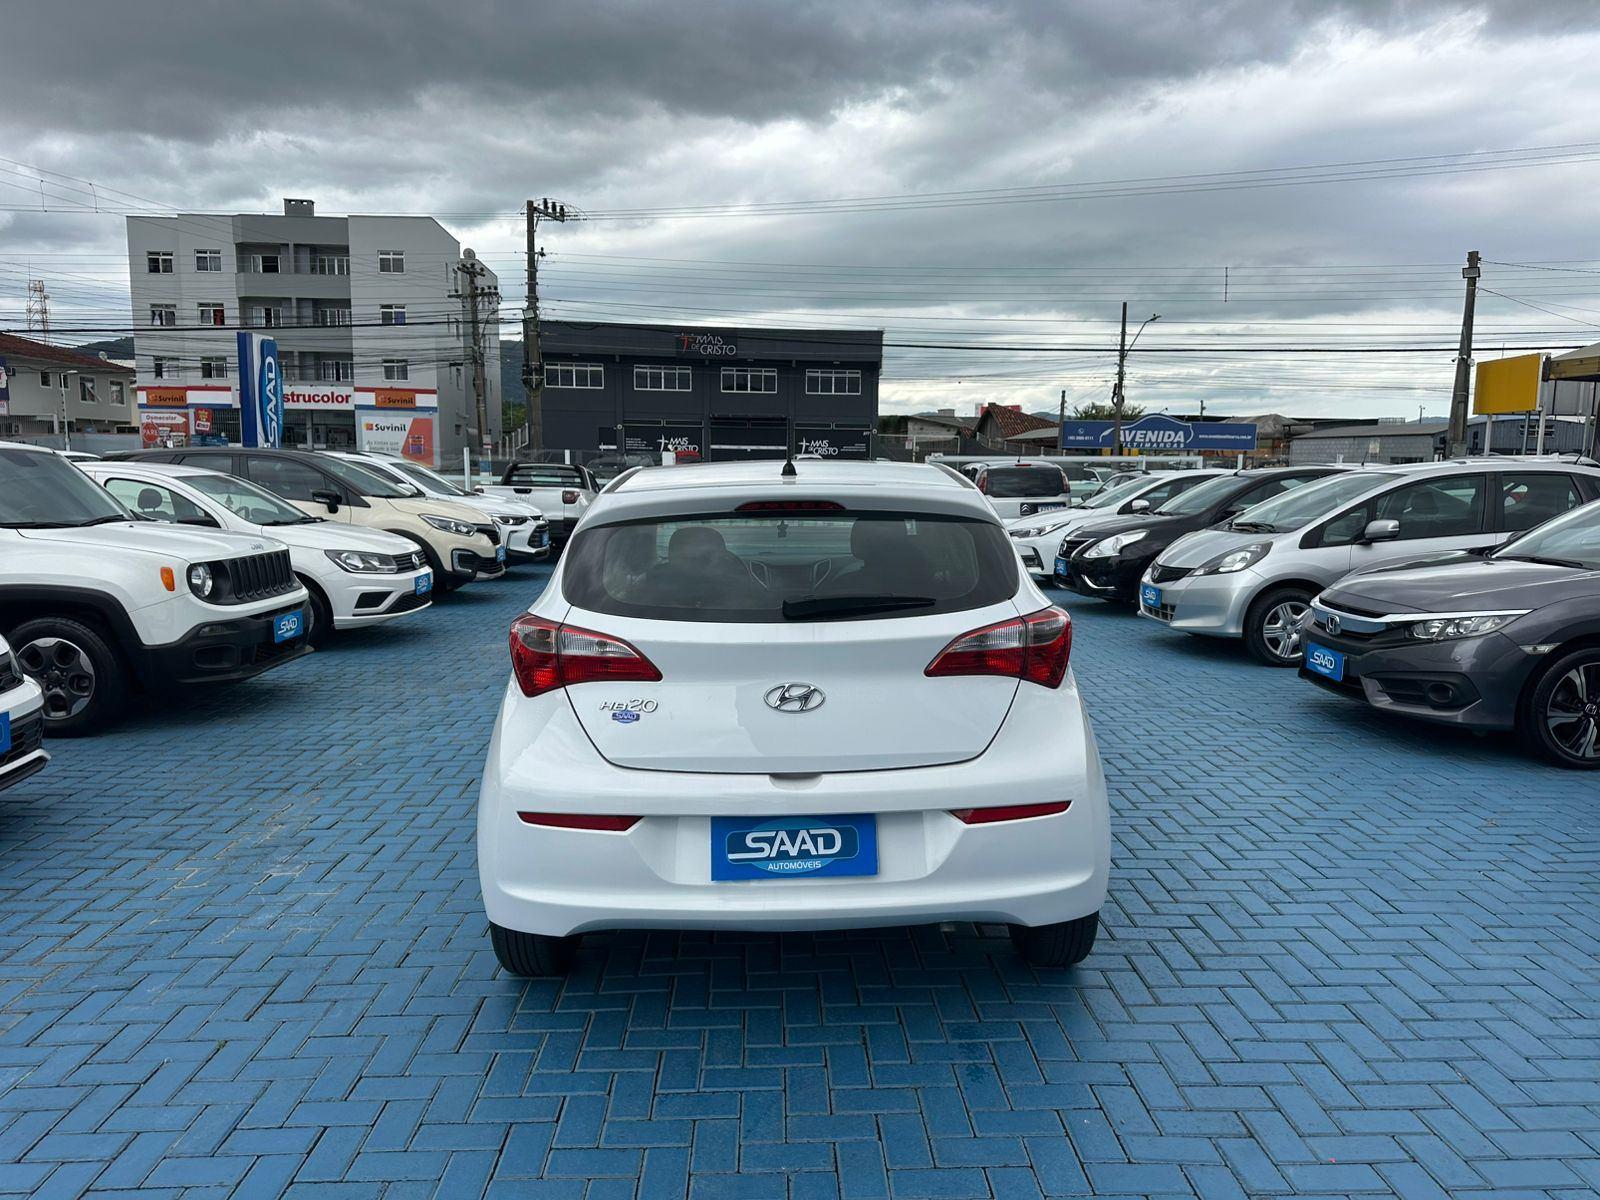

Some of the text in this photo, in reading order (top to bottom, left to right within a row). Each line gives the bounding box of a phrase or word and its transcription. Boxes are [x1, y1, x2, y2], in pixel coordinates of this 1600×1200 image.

[696, 335, 723, 345] MAIS
[700, 344, 736, 355] CRISTO
[265, 356, 279, 448] SAAD
[374, 423, 407, 432] Suvinil
[669, 437, 689, 445] MAIS
[810, 439, 829, 447] MAIS
[813, 446, 839, 455] CRISTO
[278, 617, 298, 634] SAAD
[1310, 651, 1335, 669] SAAD
[599, 699, 658, 713] HB20
[728, 828, 842, 859] SAAD
[767, 860, 822, 870] AUTOMÓVEIS
